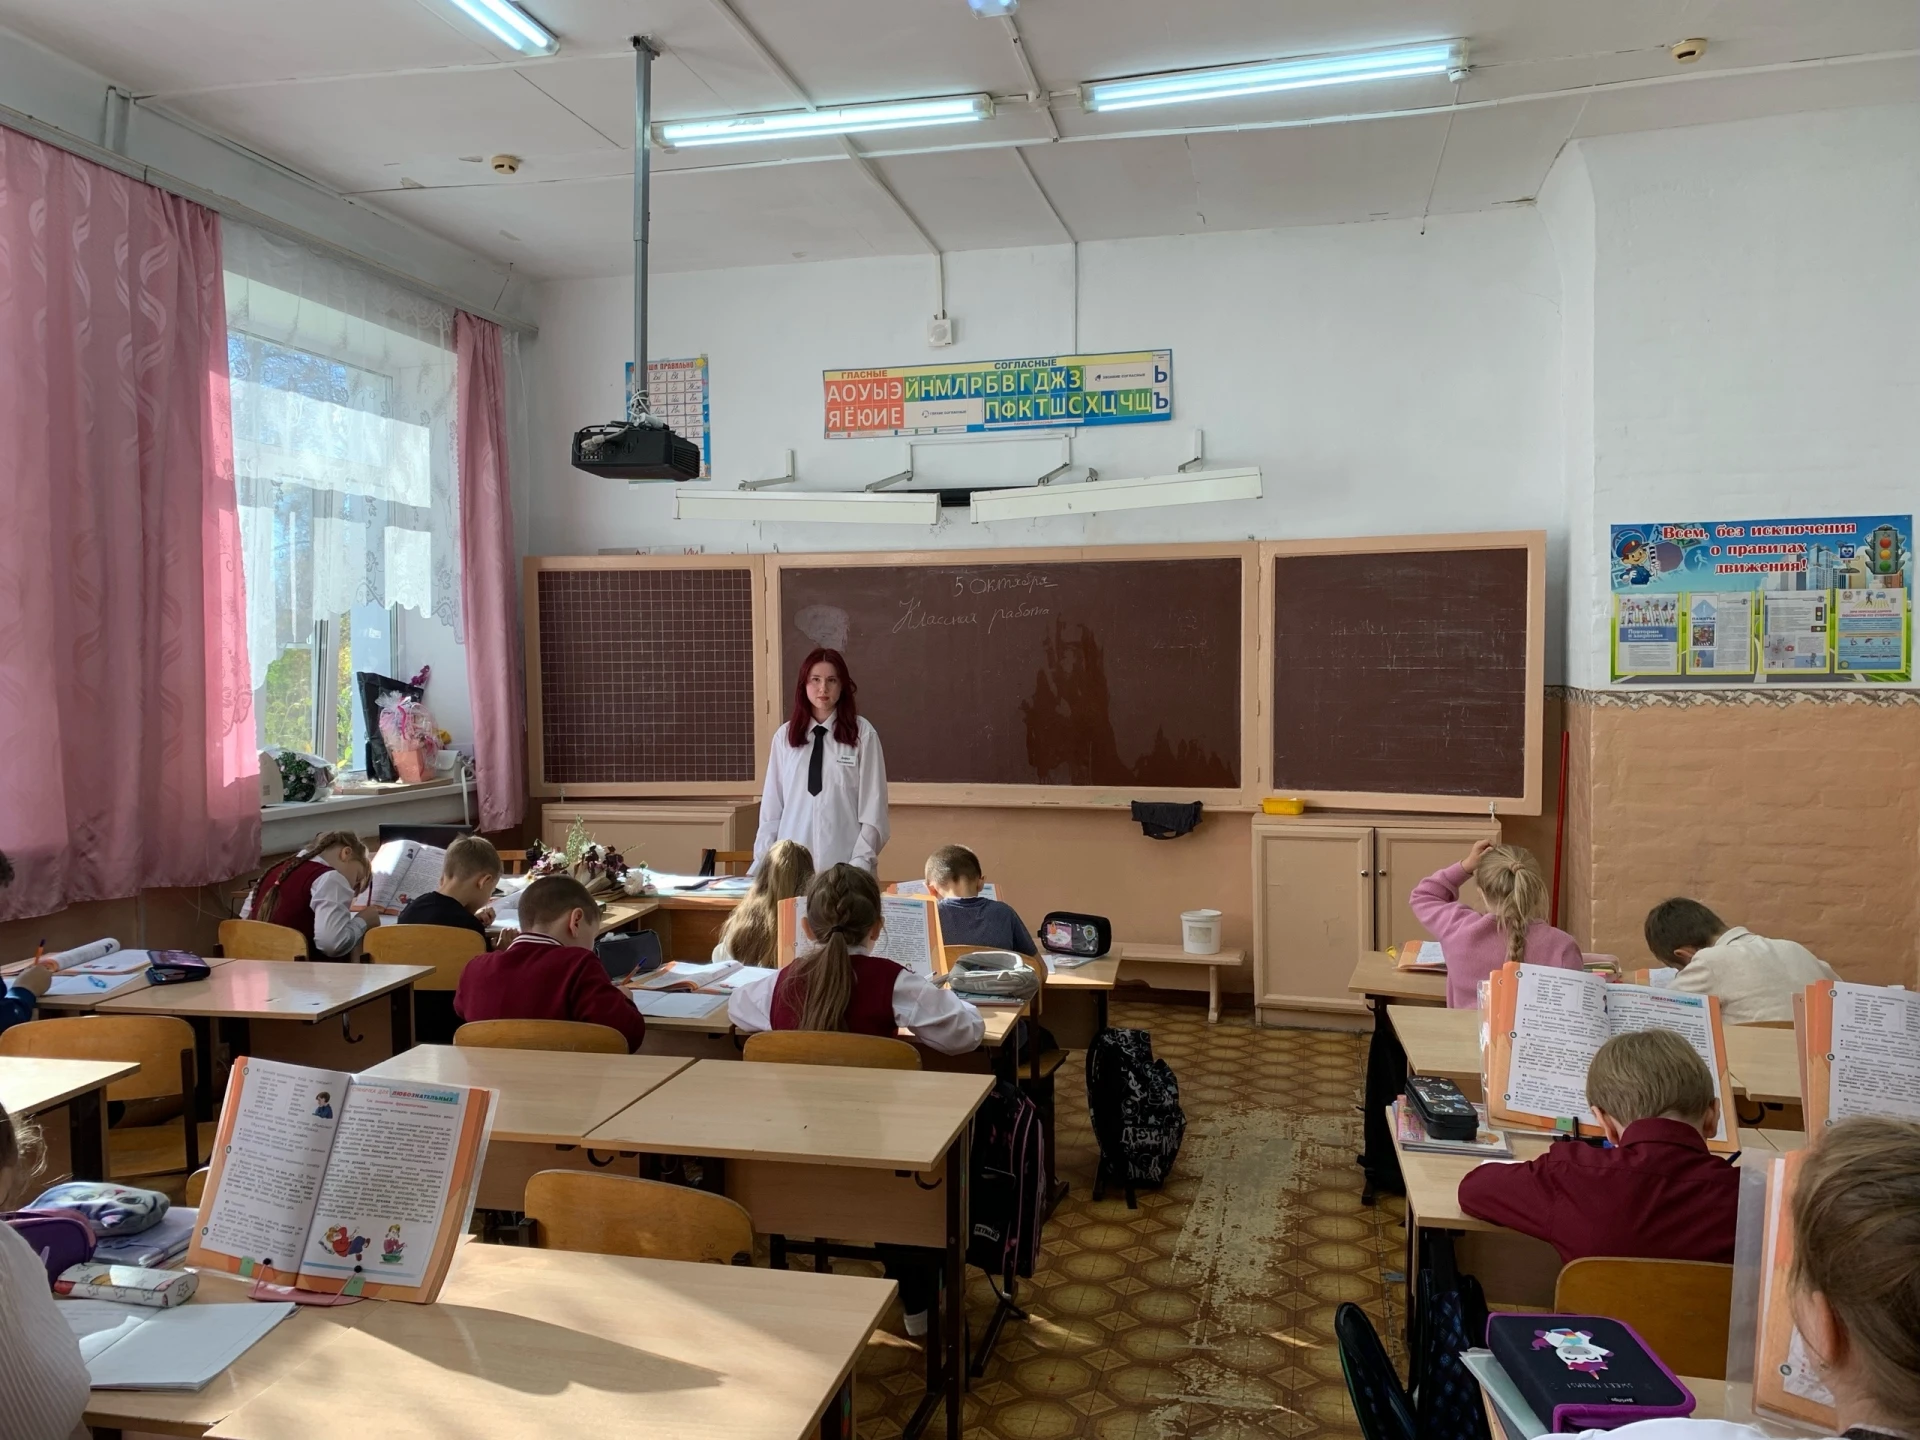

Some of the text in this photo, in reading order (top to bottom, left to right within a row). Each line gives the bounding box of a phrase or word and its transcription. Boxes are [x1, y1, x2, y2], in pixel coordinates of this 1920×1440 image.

[994, 359, 1057, 370] СОГЛАСНЫЕ
[841, 370, 888, 379] ГЛАСНЫЕ
[1155, 365, 1168, 383] Ь
[1154, 392, 1169, 409] Ъ
[1663, 523, 1856, 540] Всем, без исключения
[1710, 543, 1806, 558] о правилах
[1715, 559, 1808, 574] движения!
[953, 576, 964, 597] 5
[892, 597, 1050, 634] Классная работа
[392, 1091, 453, 1102] ЛЮБОЗНАТЕЛЬНЫХ
